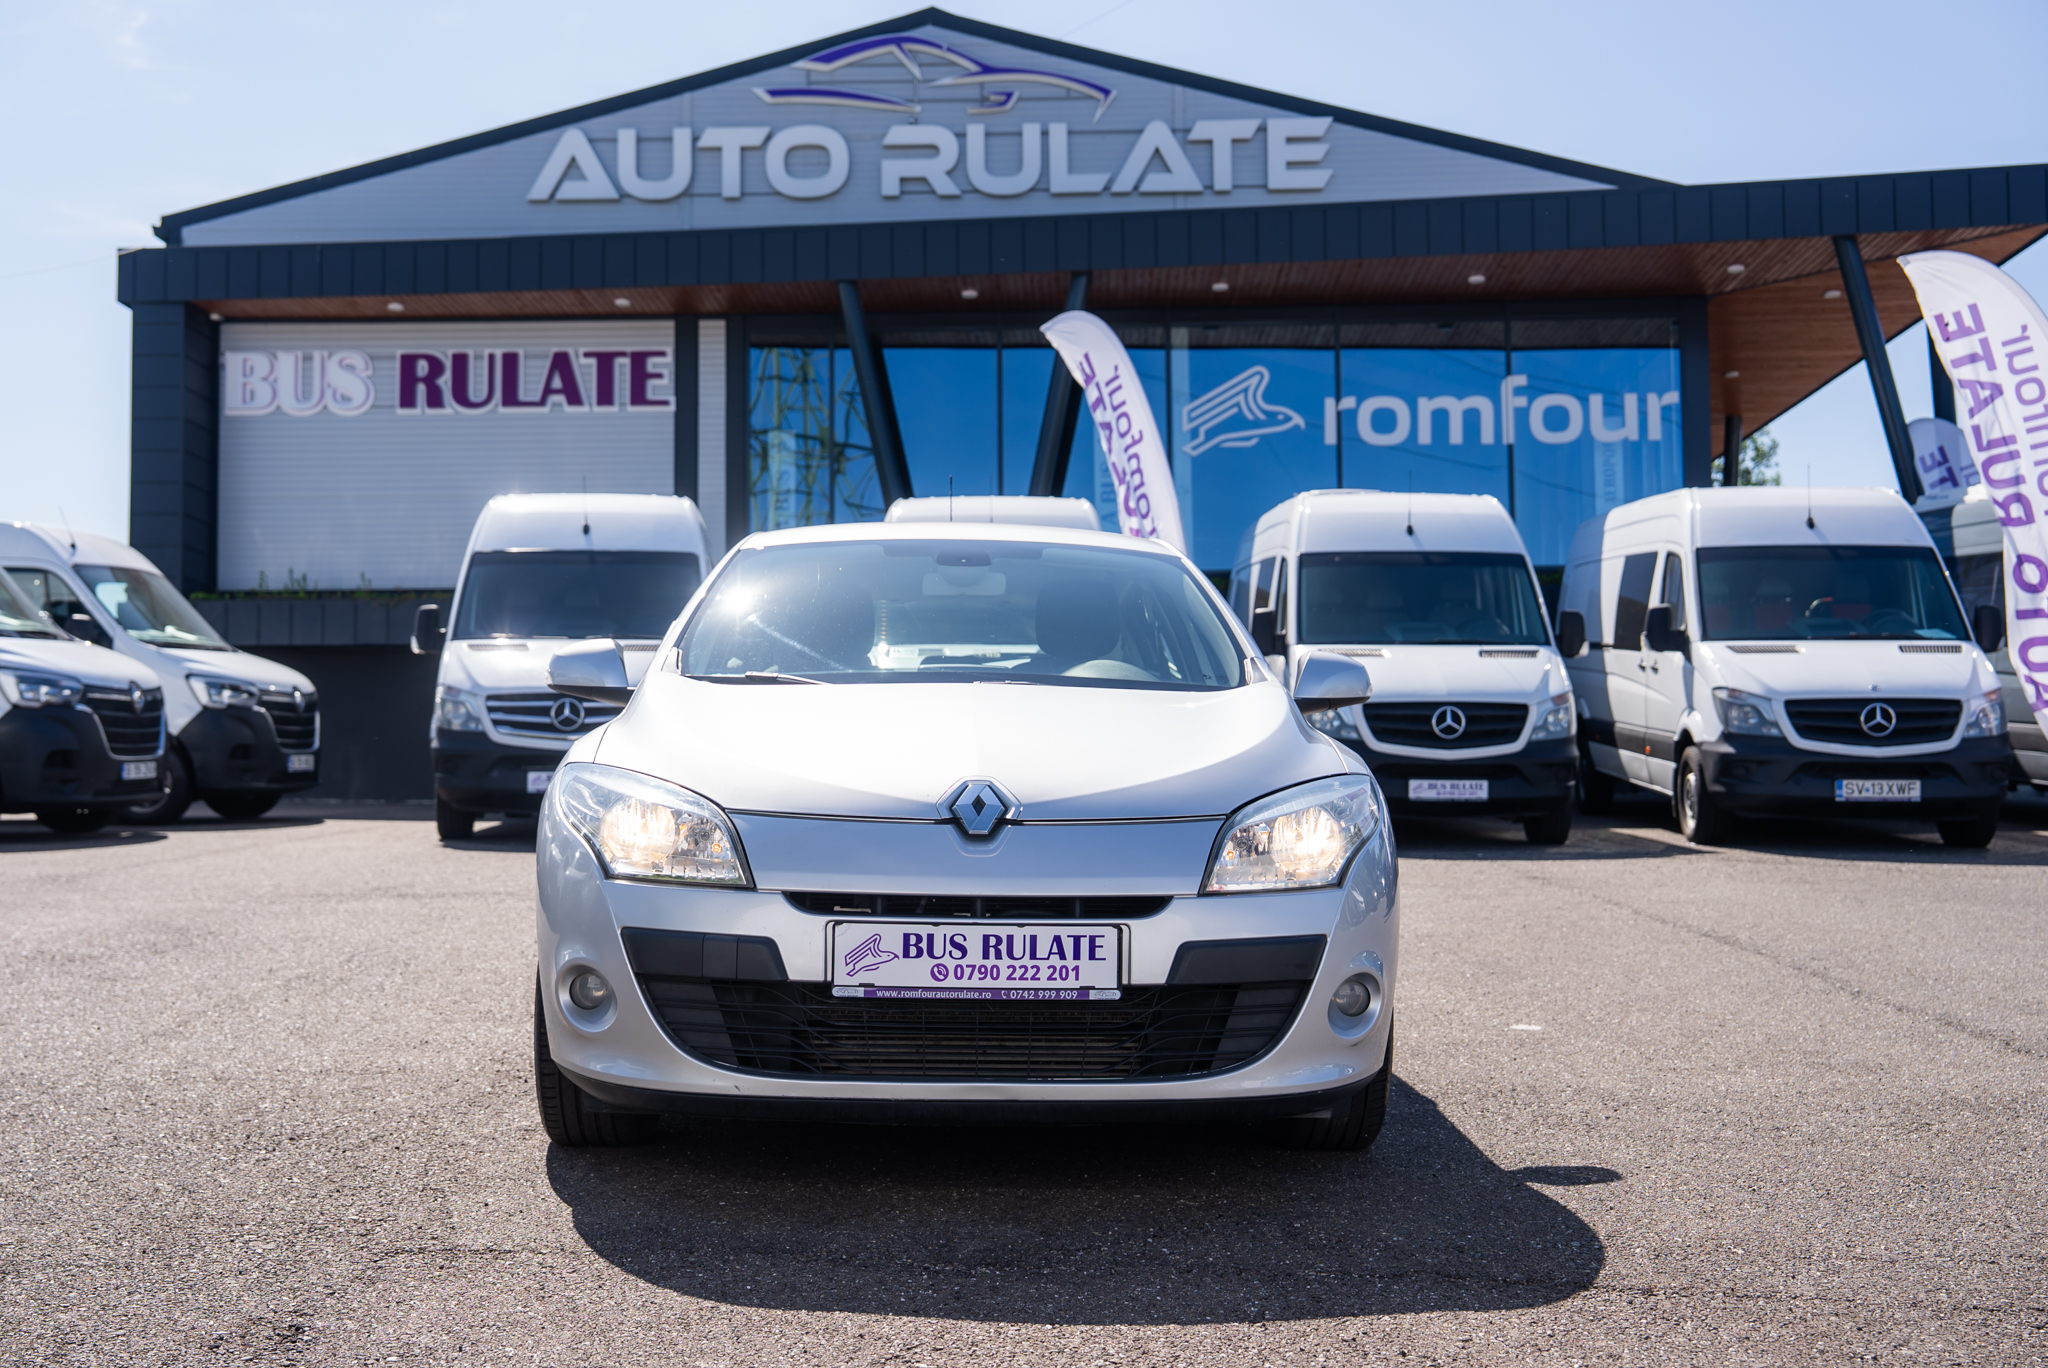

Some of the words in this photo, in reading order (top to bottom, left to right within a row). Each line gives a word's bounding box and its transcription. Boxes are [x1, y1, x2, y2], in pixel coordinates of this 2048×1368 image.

[527, 125, 850, 203] AUTO
[880, 116, 1335, 199] RULATE
[224, 349, 375, 416] BUS
[397, 347, 675, 415] RULATE
[1324, 374, 1680, 447] romfour
[902, 933, 968, 960] BUS
[982, 934, 1106, 961] RULATE
[876, 989, 992, 999] www.romfourautorulate.ro
[1010, 990, 1035, 999] 0742
[1038, 990, 1056, 999] 999
[1060, 990, 1078, 999] 909
[953, 964, 1000, 981] 0790
[1006, 965, 1041, 981] 222
[1046, 965, 1080, 982] 201
